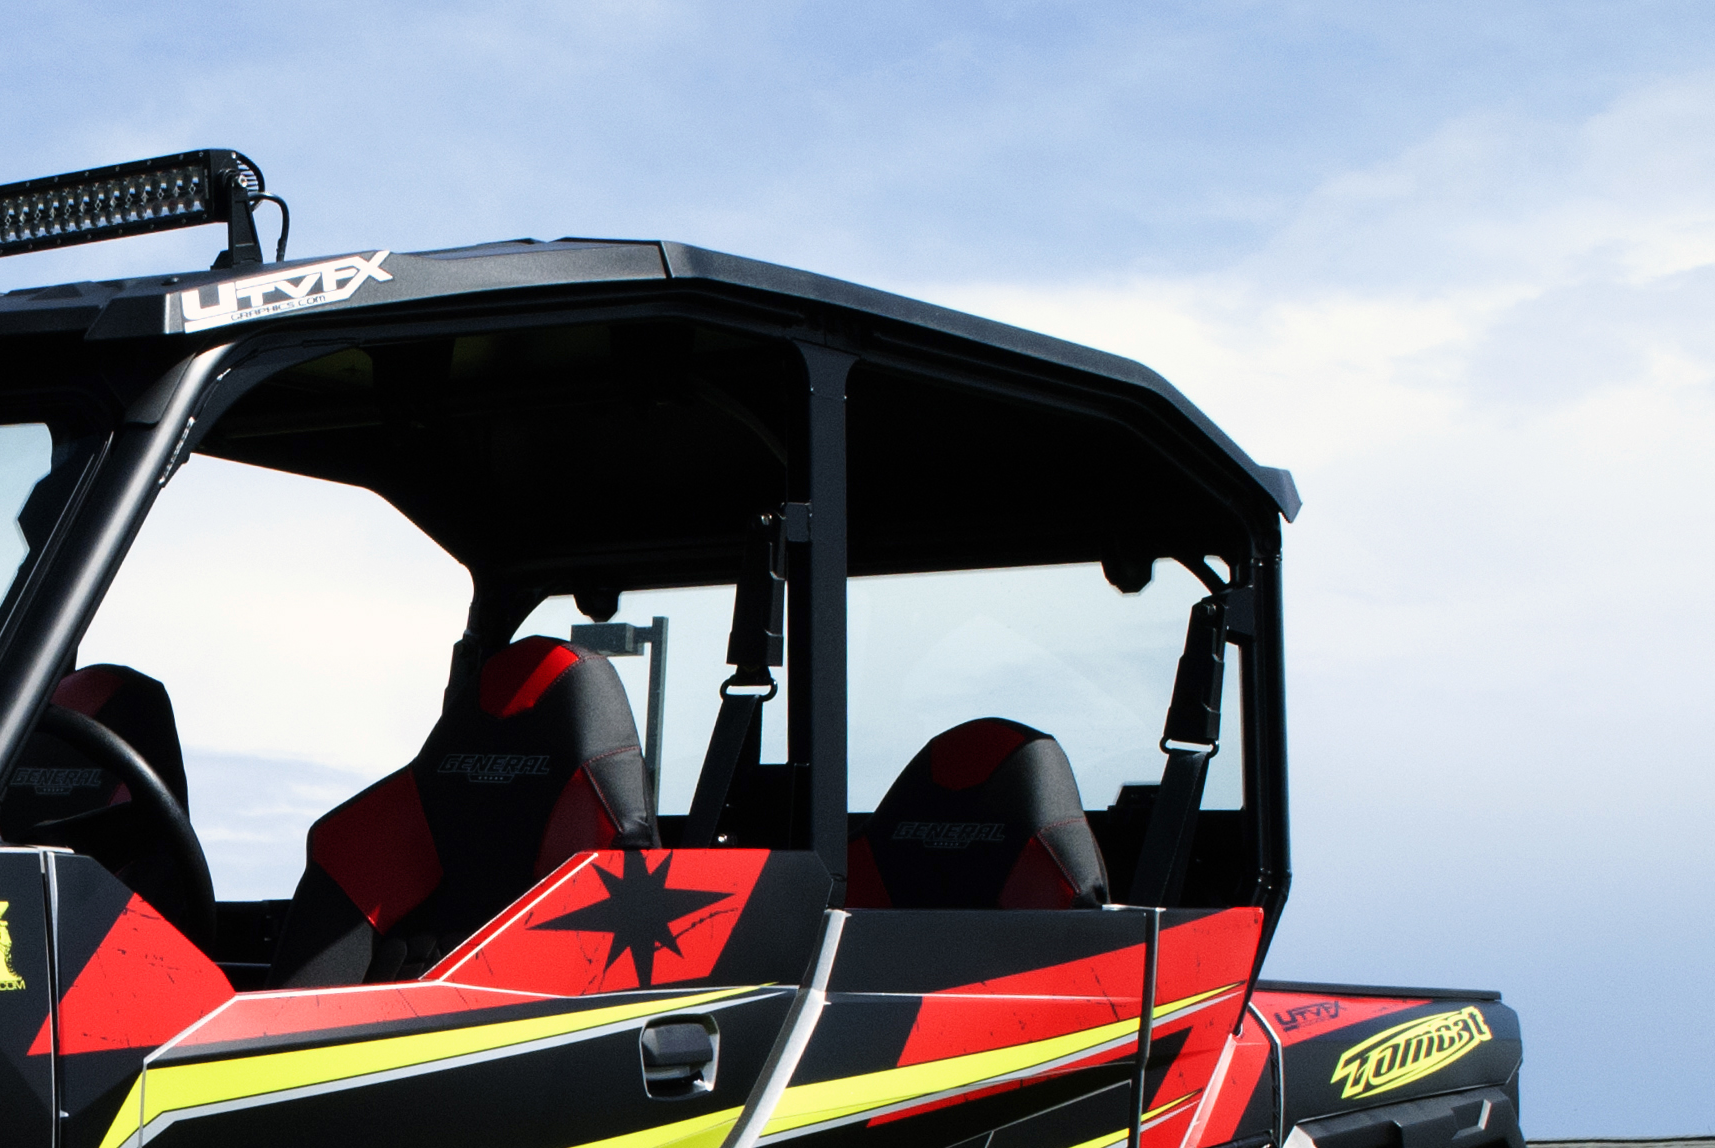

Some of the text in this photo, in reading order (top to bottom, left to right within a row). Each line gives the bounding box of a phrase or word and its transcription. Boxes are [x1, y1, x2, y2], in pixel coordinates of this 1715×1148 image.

[182, 250, 394, 333] UTVFX
[437, 754, 550, 774] GENERAL
[10, 768, 102, 787] GENERAL
[891, 821, 1005, 841] GENERAL
